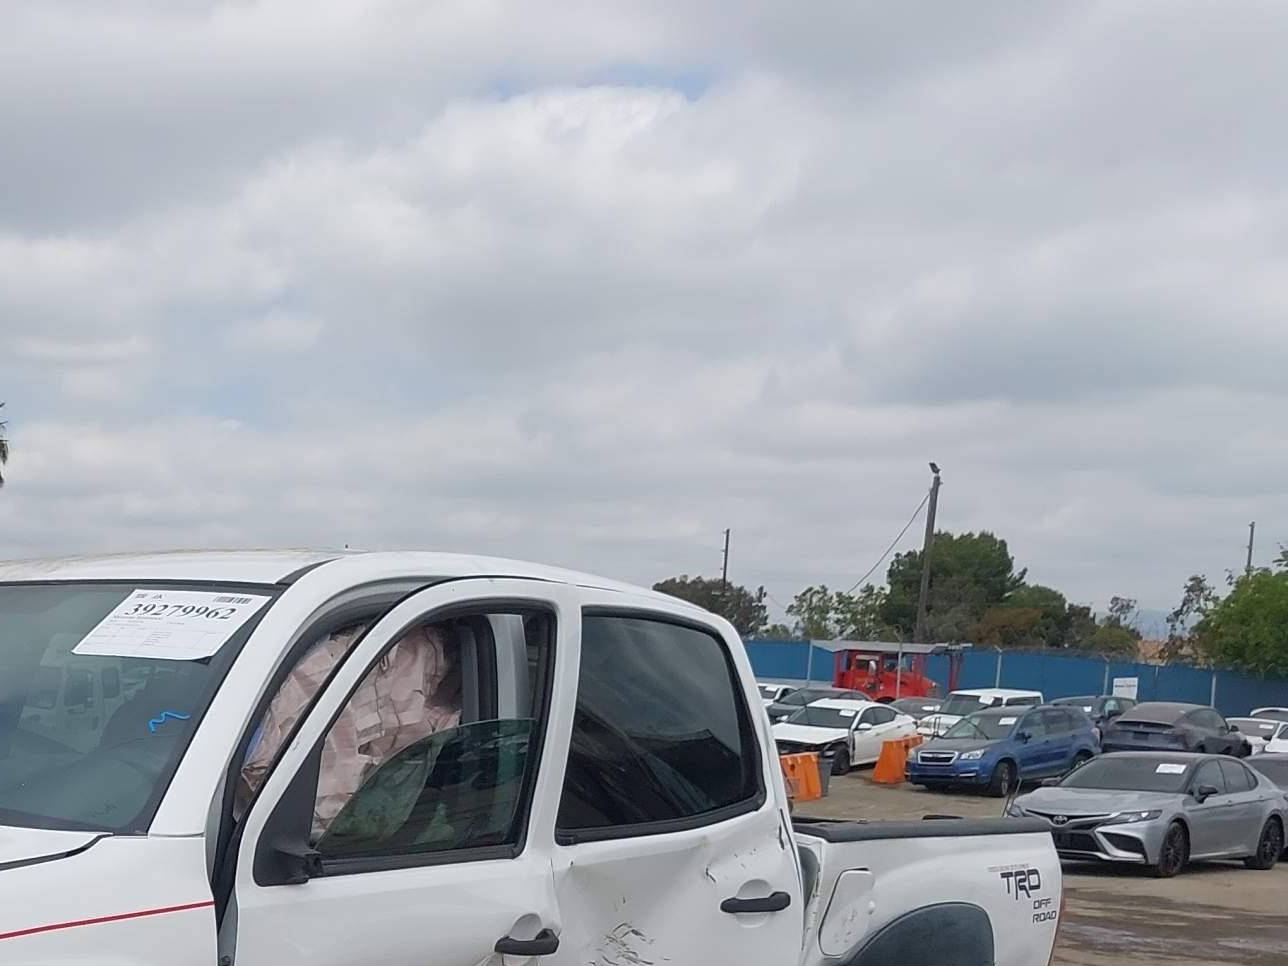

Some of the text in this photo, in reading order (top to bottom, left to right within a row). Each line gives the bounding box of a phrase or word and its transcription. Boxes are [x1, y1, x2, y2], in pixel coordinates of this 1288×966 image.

[124, 603, 238, 620] 39279962
[1000, 868, 1041, 900] TRD
[1033, 898, 1052, 909] OFF
[1032, 911, 1057, 923] ROAD
